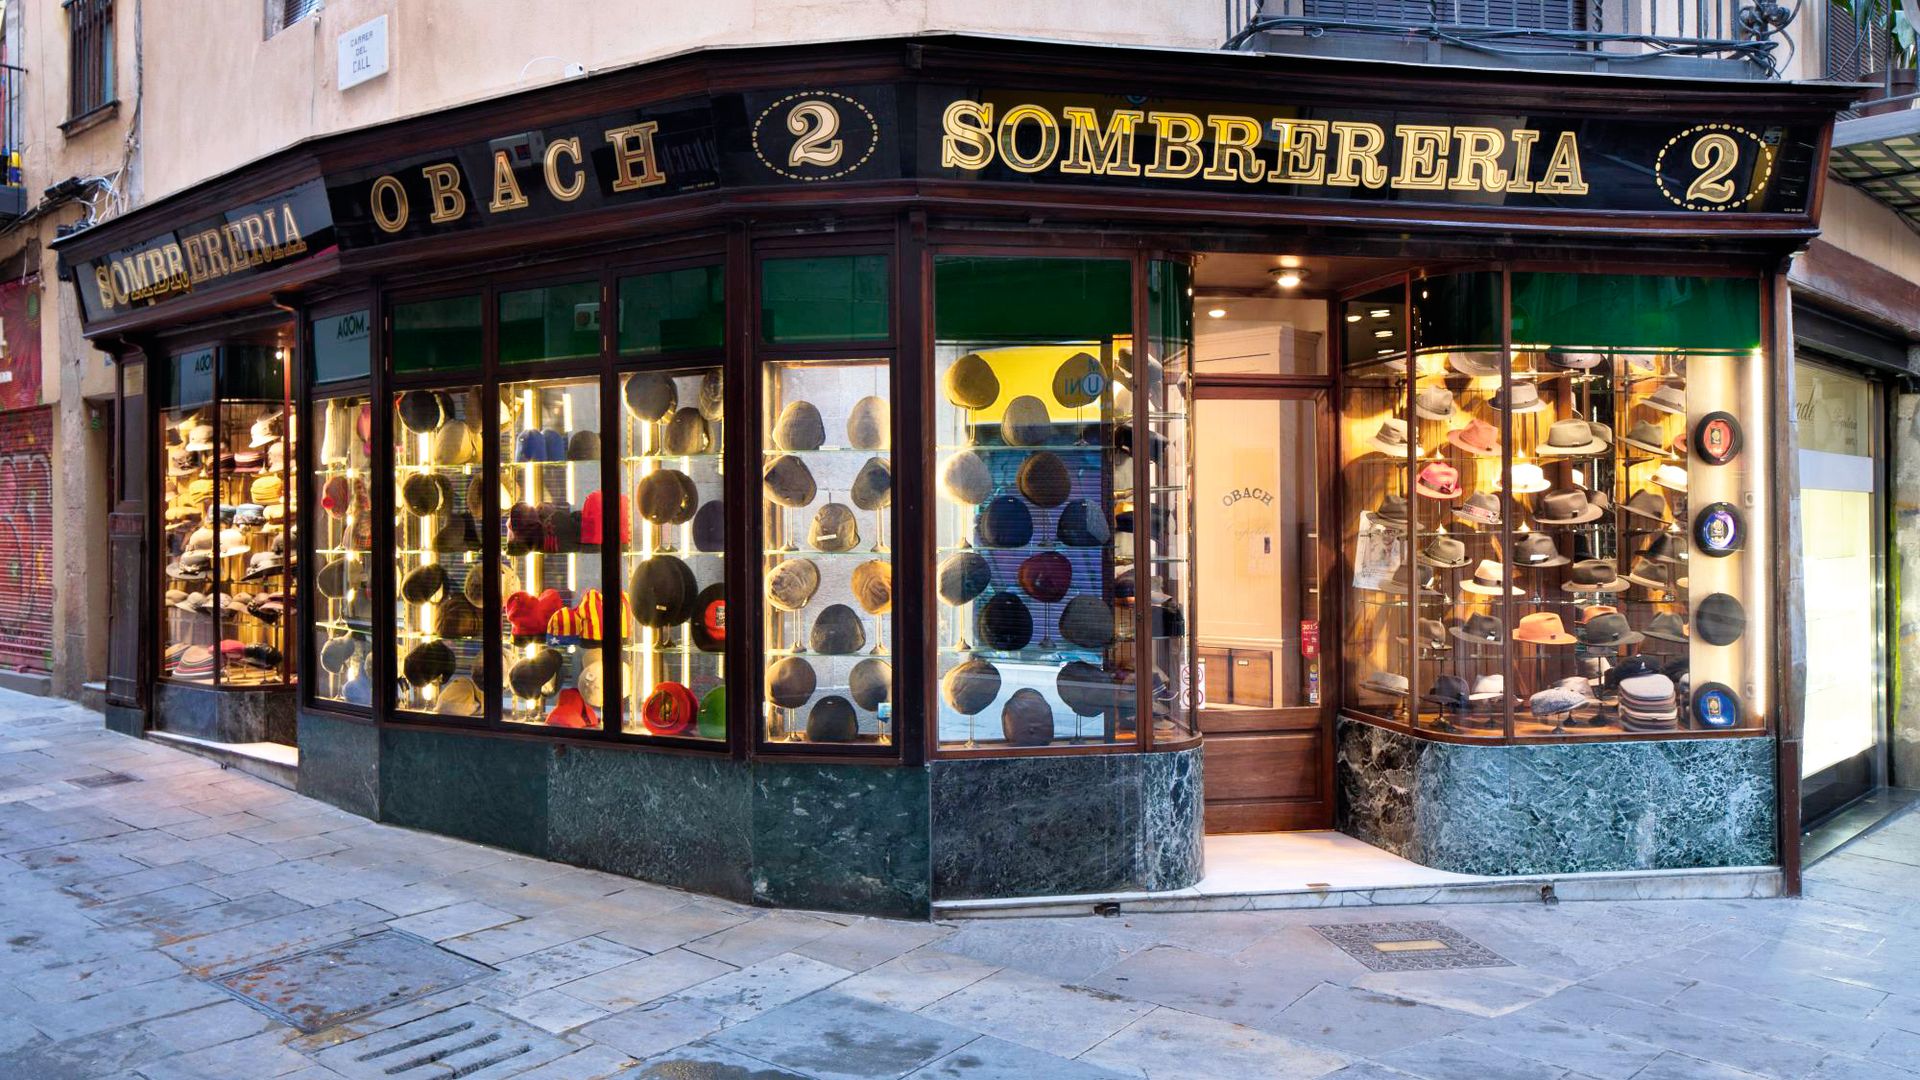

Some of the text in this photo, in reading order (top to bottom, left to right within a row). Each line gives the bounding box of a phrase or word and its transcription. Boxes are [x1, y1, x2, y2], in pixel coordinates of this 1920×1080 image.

[350, 30, 373, 47] CARRER
[353, 55, 371, 73] CALL
[355, 46, 367, 56] DEL
[787, 100, 842, 167] 2
[942, 100, 1589, 196] SOMBRERERIA
[370, 120, 666, 233] OBACH
[1686, 133, 1739, 203] 2
[95, 203, 307, 309] SOMBRERERIA
[1222, 487, 1274, 507] OBACH
